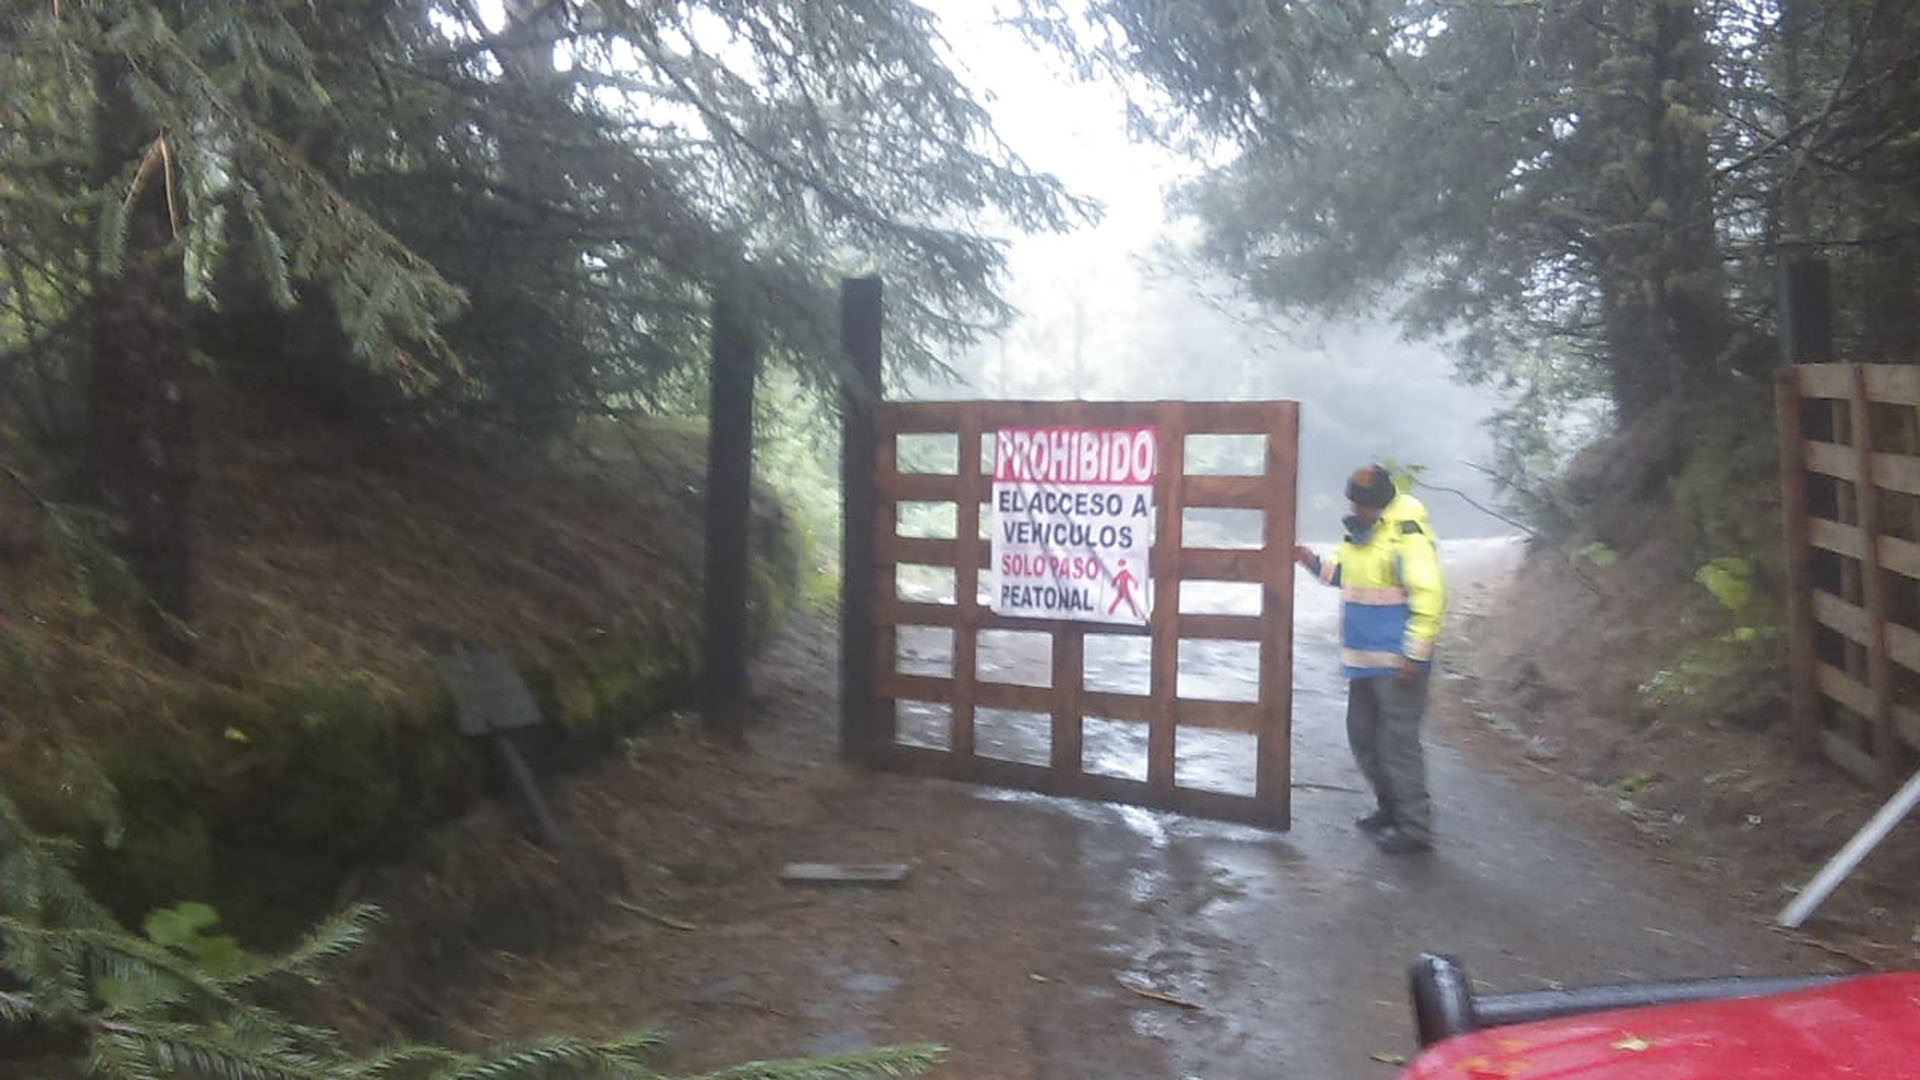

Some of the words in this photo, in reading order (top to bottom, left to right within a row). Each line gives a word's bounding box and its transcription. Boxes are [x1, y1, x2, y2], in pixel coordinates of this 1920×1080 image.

[996, 430, 1154, 482] PROHIBIDO
[999, 491, 1023, 513] EL
[1029, 493, 1122, 516] ACCESO
[1132, 494, 1148, 517] A
[1003, 521, 1133, 549] VEHICULOS
[1002, 554, 1045, 577] SOLO
[1050, 556, 1099, 580] PASO
[1001, 585, 1094, 611] PEATONAL
